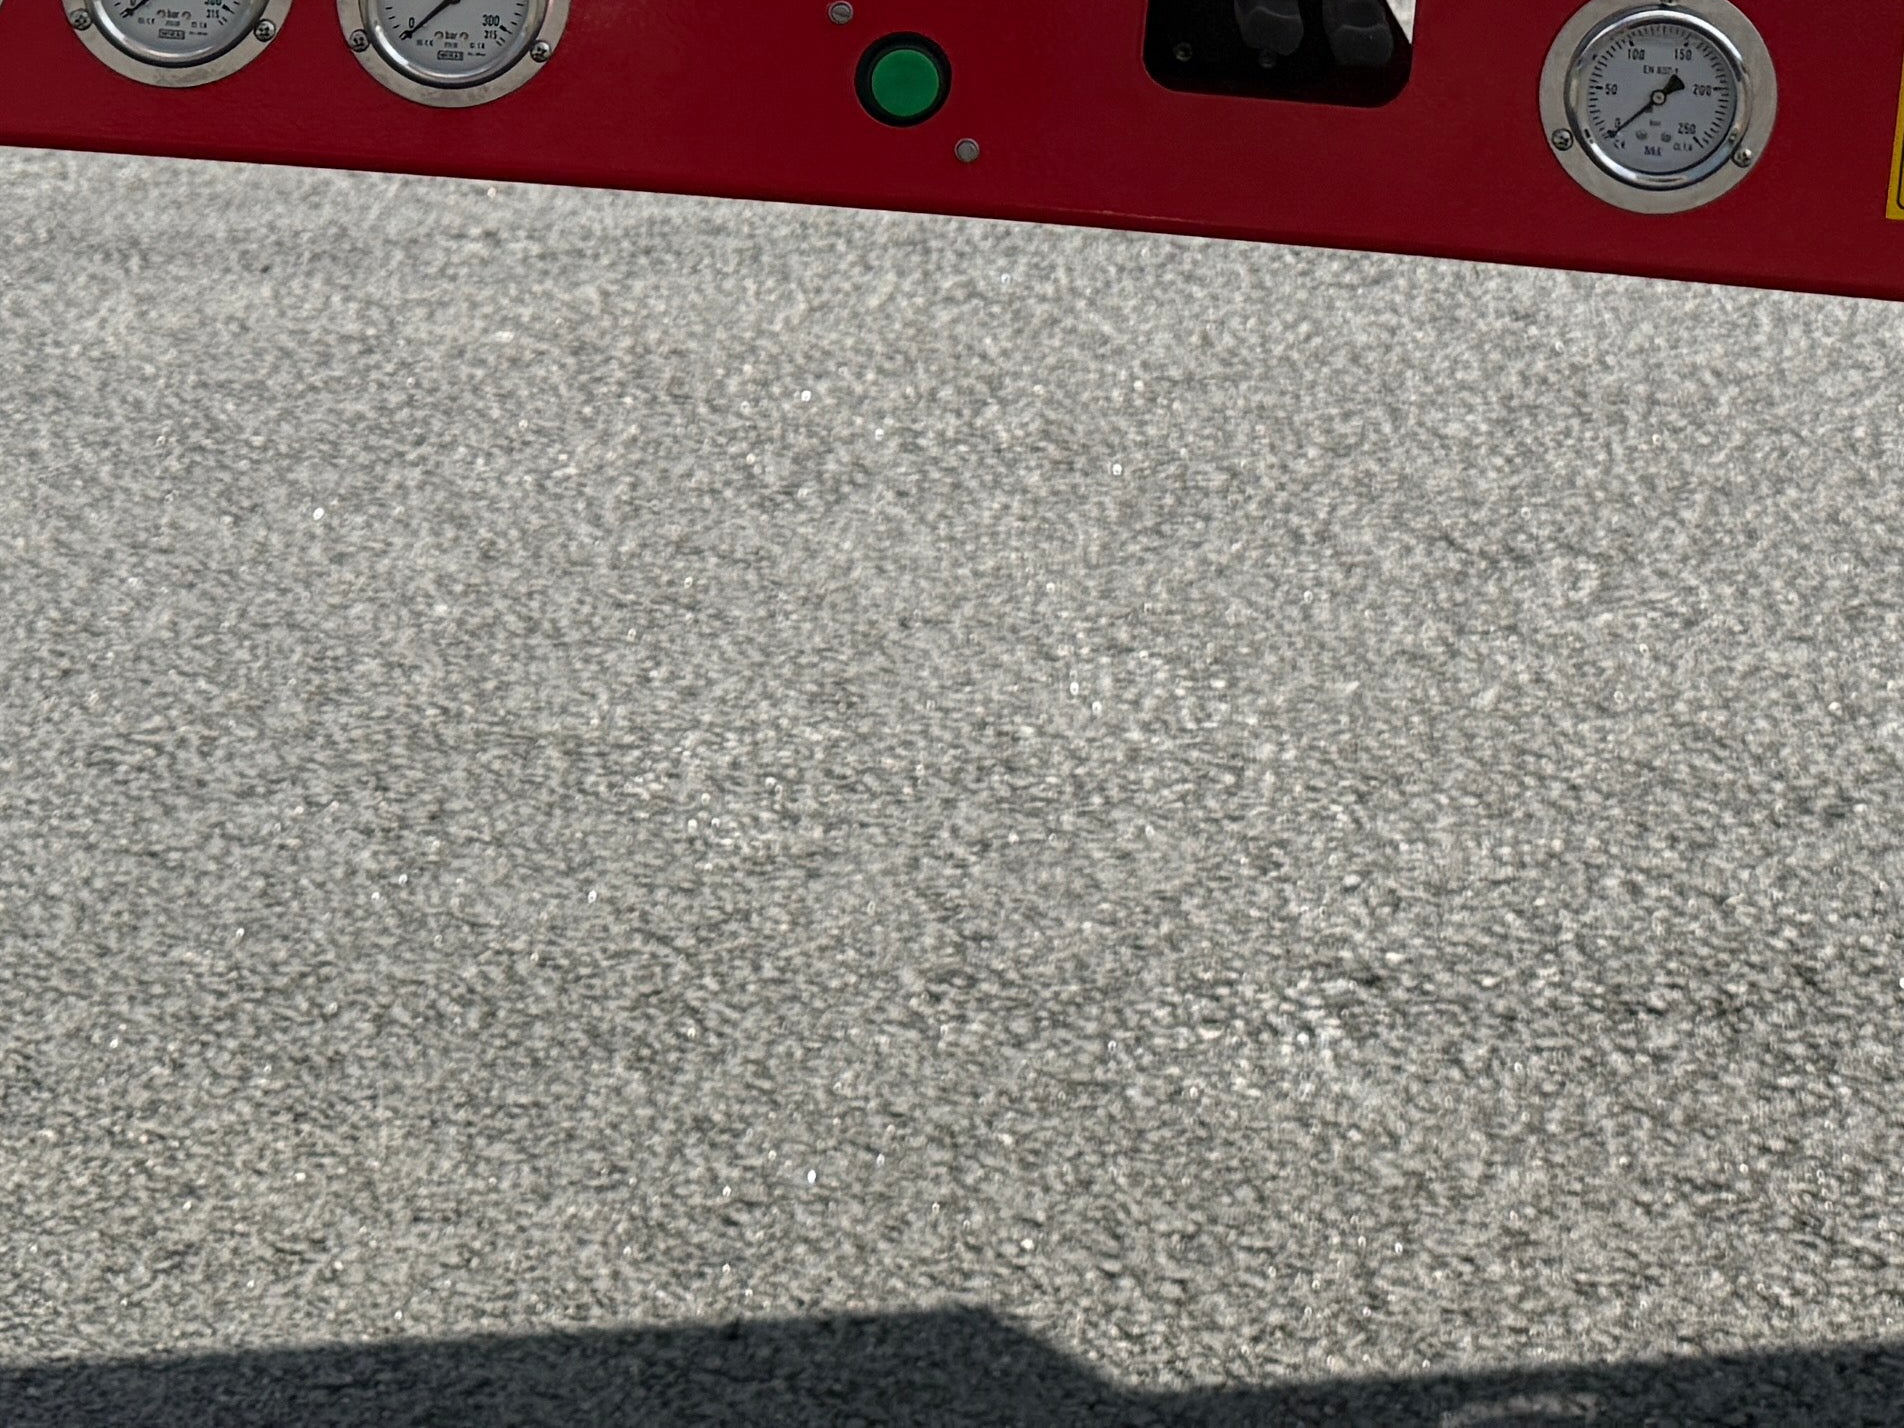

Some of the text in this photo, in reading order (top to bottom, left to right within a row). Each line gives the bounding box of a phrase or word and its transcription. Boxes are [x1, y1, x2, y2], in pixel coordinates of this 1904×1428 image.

[1627, 48, 1693, 61] 100 150
[1605, 83, 1618, 96] 50
